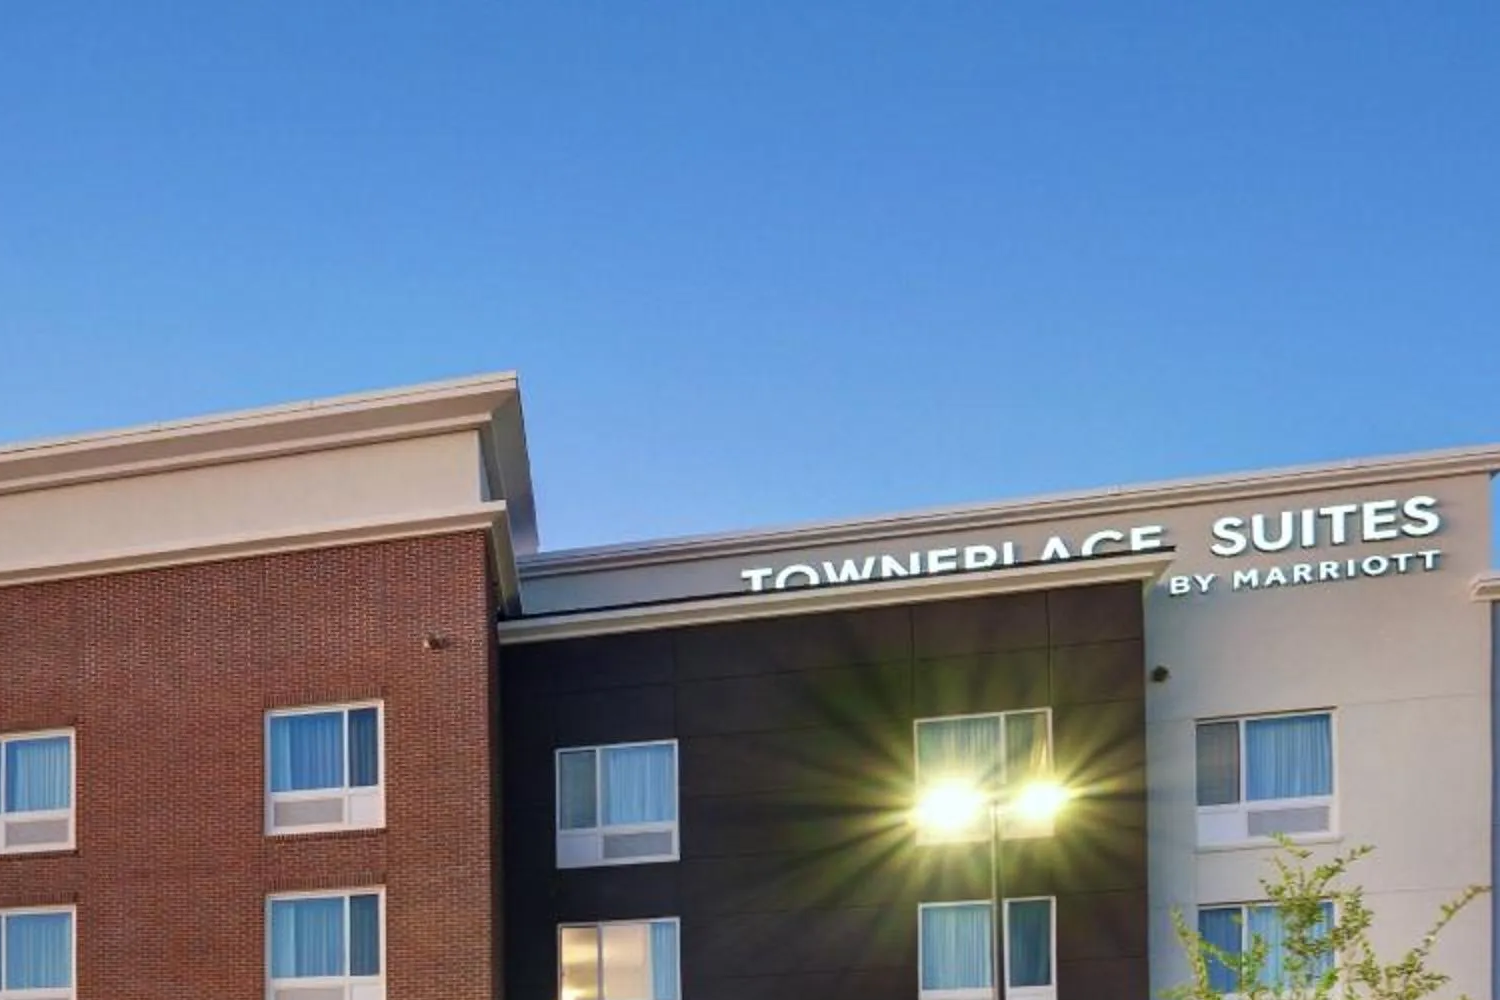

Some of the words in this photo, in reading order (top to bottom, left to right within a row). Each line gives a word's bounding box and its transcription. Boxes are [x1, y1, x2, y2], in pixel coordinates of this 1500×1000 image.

[741, 525, 1163, 592] TOWNEPLACE
[1210, 496, 1441, 556] SUITES
[1170, 574, 1215, 595] BY
[1233, 550, 1441, 589] MARRIOTT
